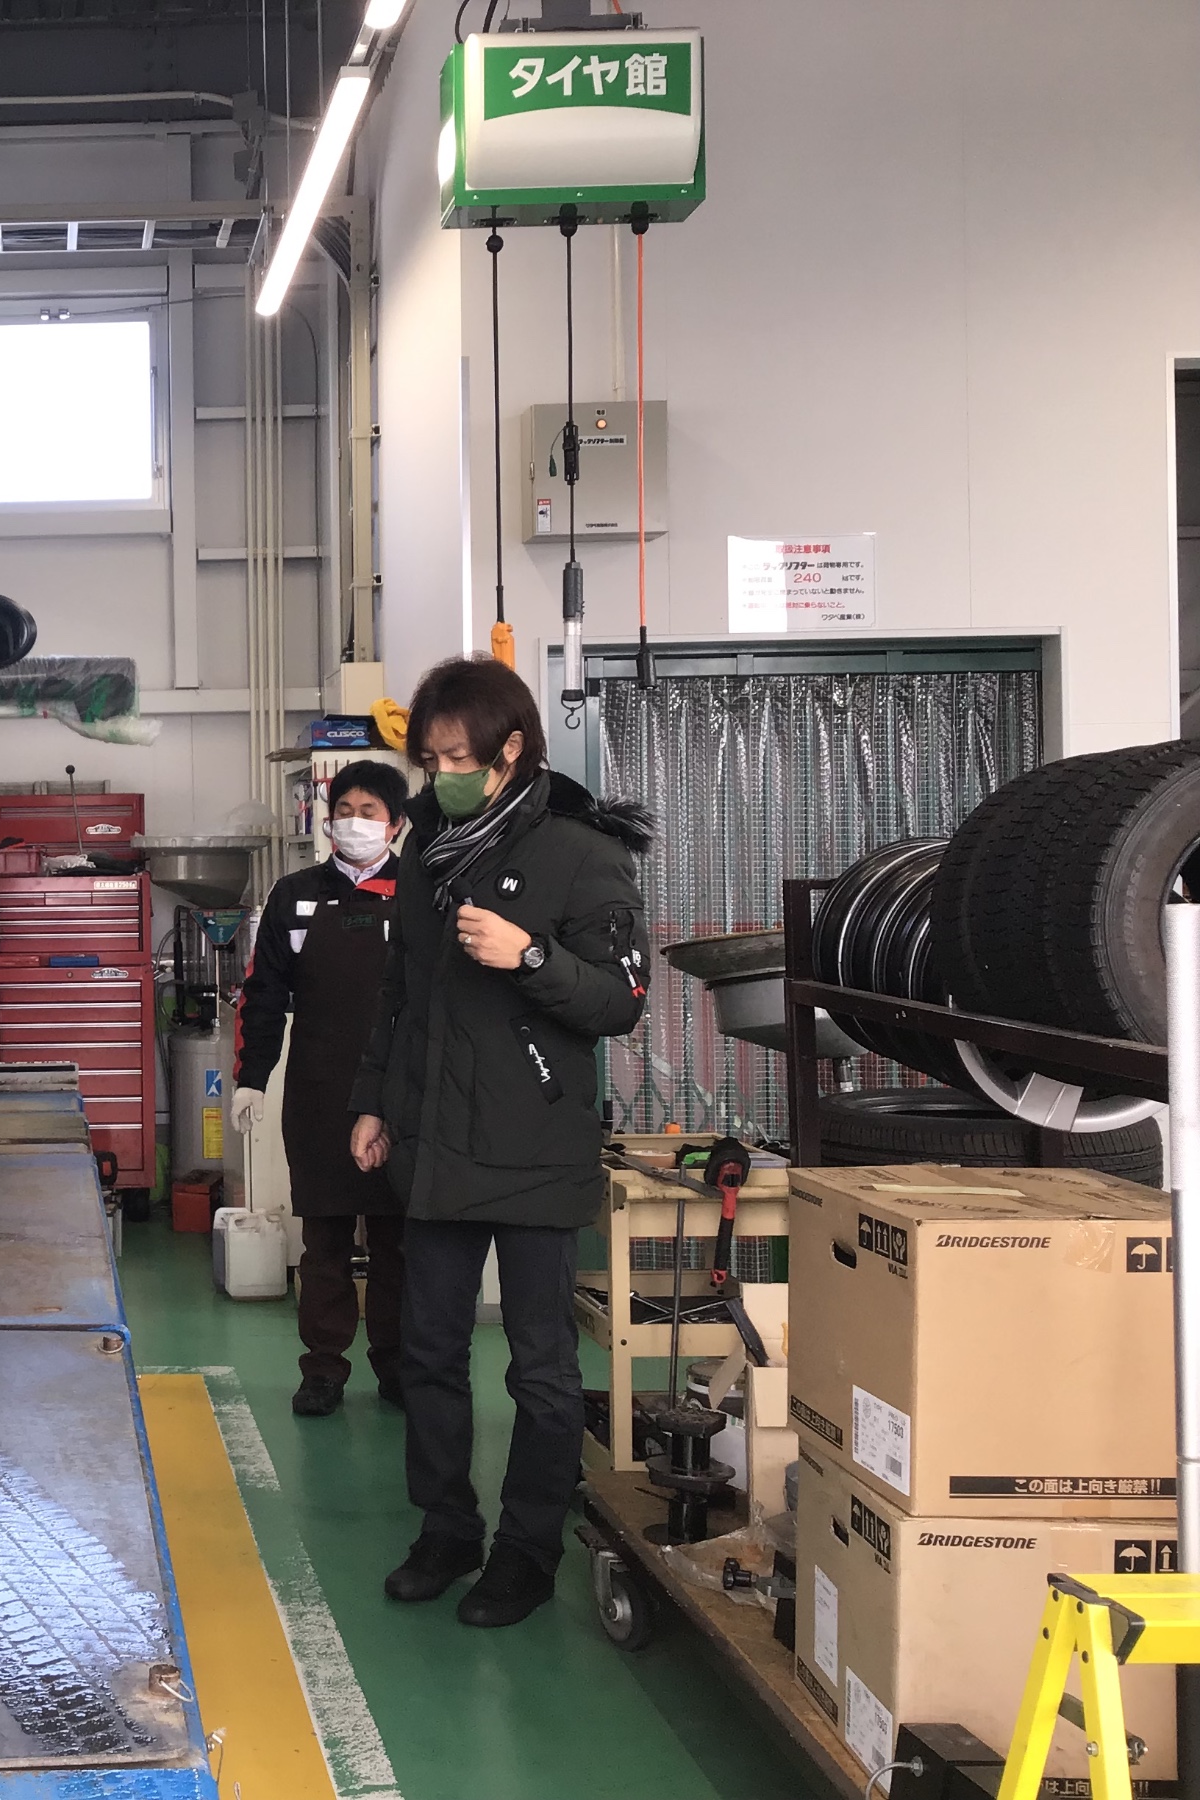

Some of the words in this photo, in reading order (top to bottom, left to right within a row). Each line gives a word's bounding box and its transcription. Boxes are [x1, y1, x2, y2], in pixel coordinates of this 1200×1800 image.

[508, 52, 668, 98] タイヤ館
[793, 572, 822, 584] 240
[935, 1234, 1052, 1249] BRIDGESTONE
[917, 1532, 1038, 1549] BRIDGESTONE
